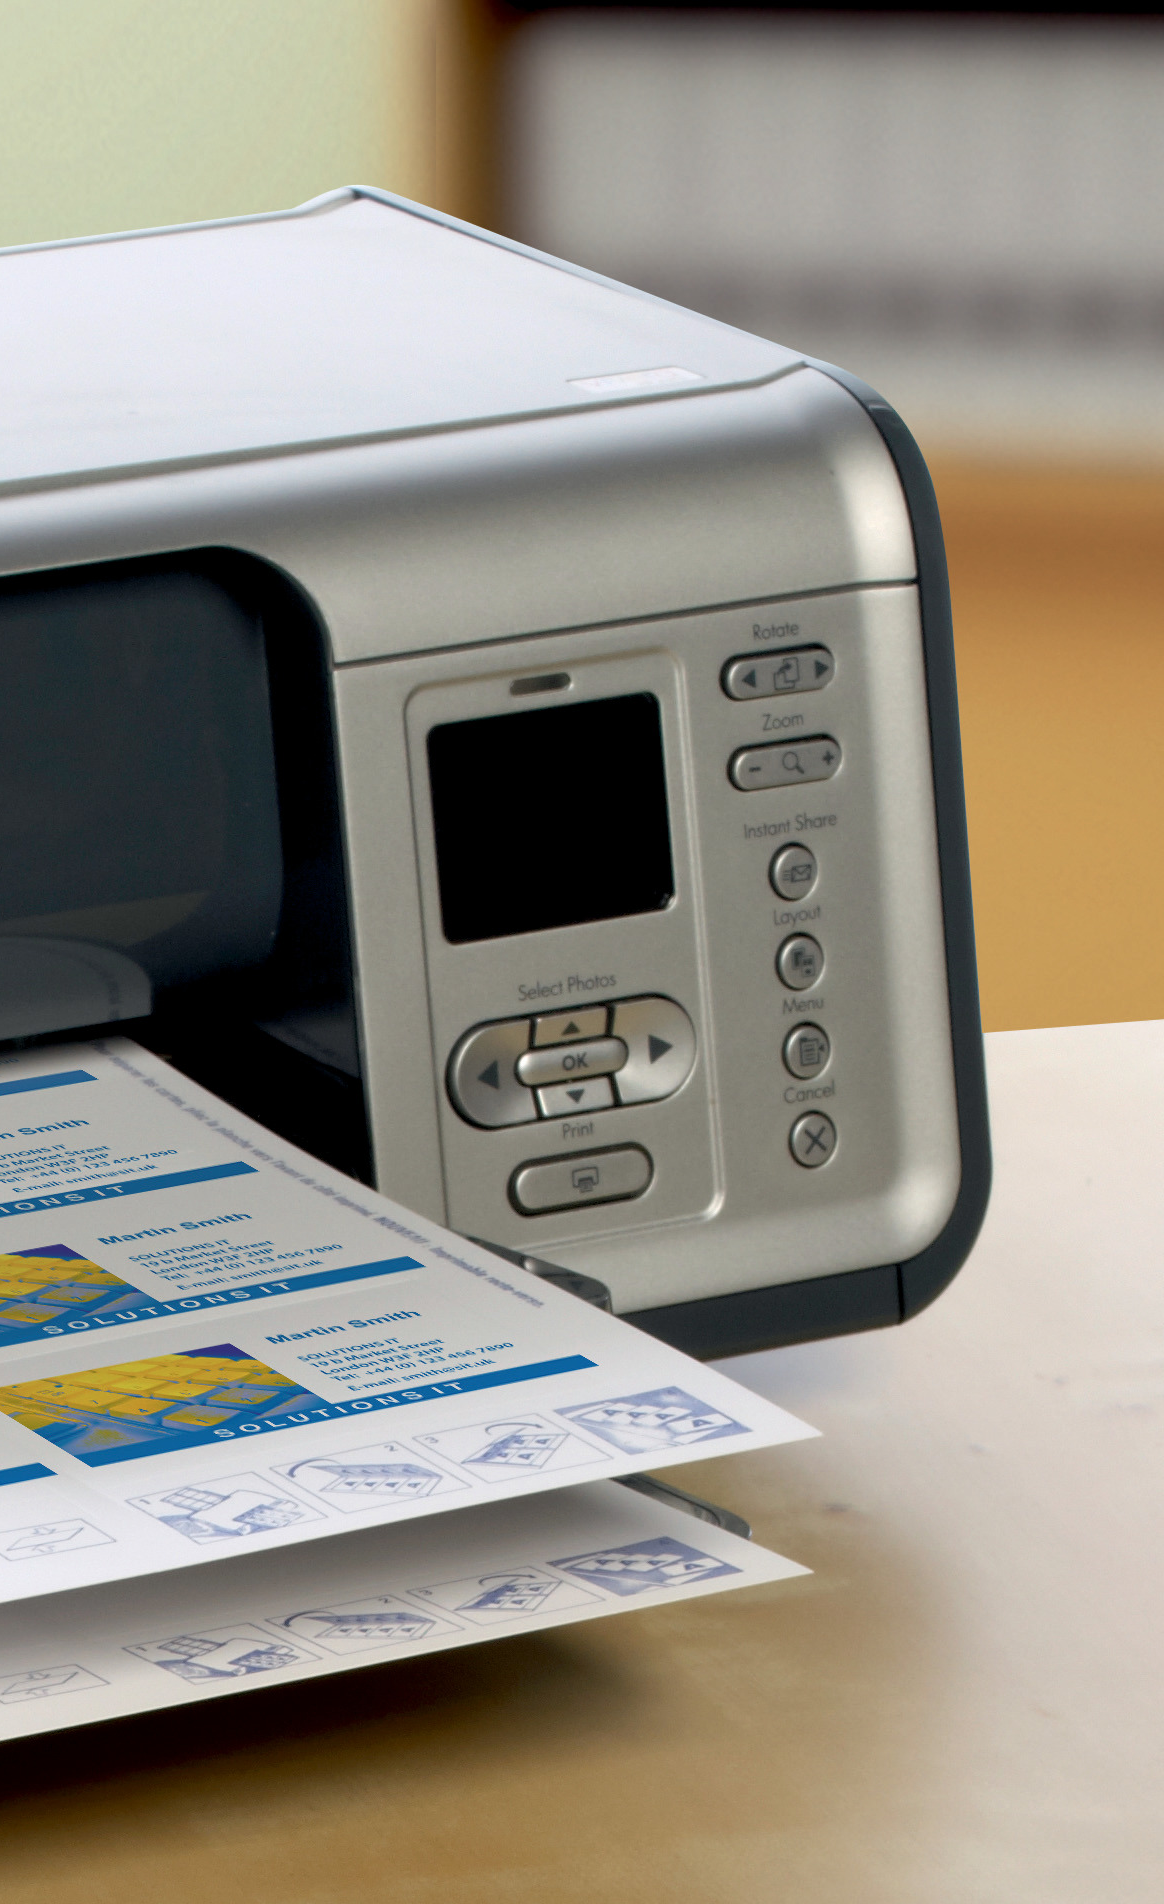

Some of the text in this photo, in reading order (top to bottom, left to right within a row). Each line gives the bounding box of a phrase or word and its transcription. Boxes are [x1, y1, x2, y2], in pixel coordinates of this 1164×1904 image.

[752, 622, 800, 640] Rotate
[762, 711, 804, 730] Zoom
[743, 811, 837, 840] Instant Share
[773, 905, 821, 928] Layout
[518, 970, 617, 1001] Select Photos
[782, 995, 824, 1013] Menu
[563, 1053, 587, 1071] OK
[784, 1080, 834, 1103] Cancel
[17, 1119, 90, 1136] Smith
[562, 1121, 594, 1139] Print
[93, 1185, 124, 1197] IT
[97, 1213, 253, 1245] Martin Smith
[128, 1242, 215, 1262] SOLUTIONS
[173, 1248, 228, 1263] Market
[227, 1240, 275, 1252] Street
[149, 1261, 210, 1275] London
[42, 1281, 290, 1335] SOLUTIONS IT
[265, 1310, 421, 1345] Martin Smith
[297, 1341, 385, 1362] SOLUTIONS
[343, 1347, 398, 1362] Market
[397, 1338, 445, 1351] Street
[319, 1360, 380, 1376] London
[213, 1381, 463, 1438] SOLUTIONS IT
